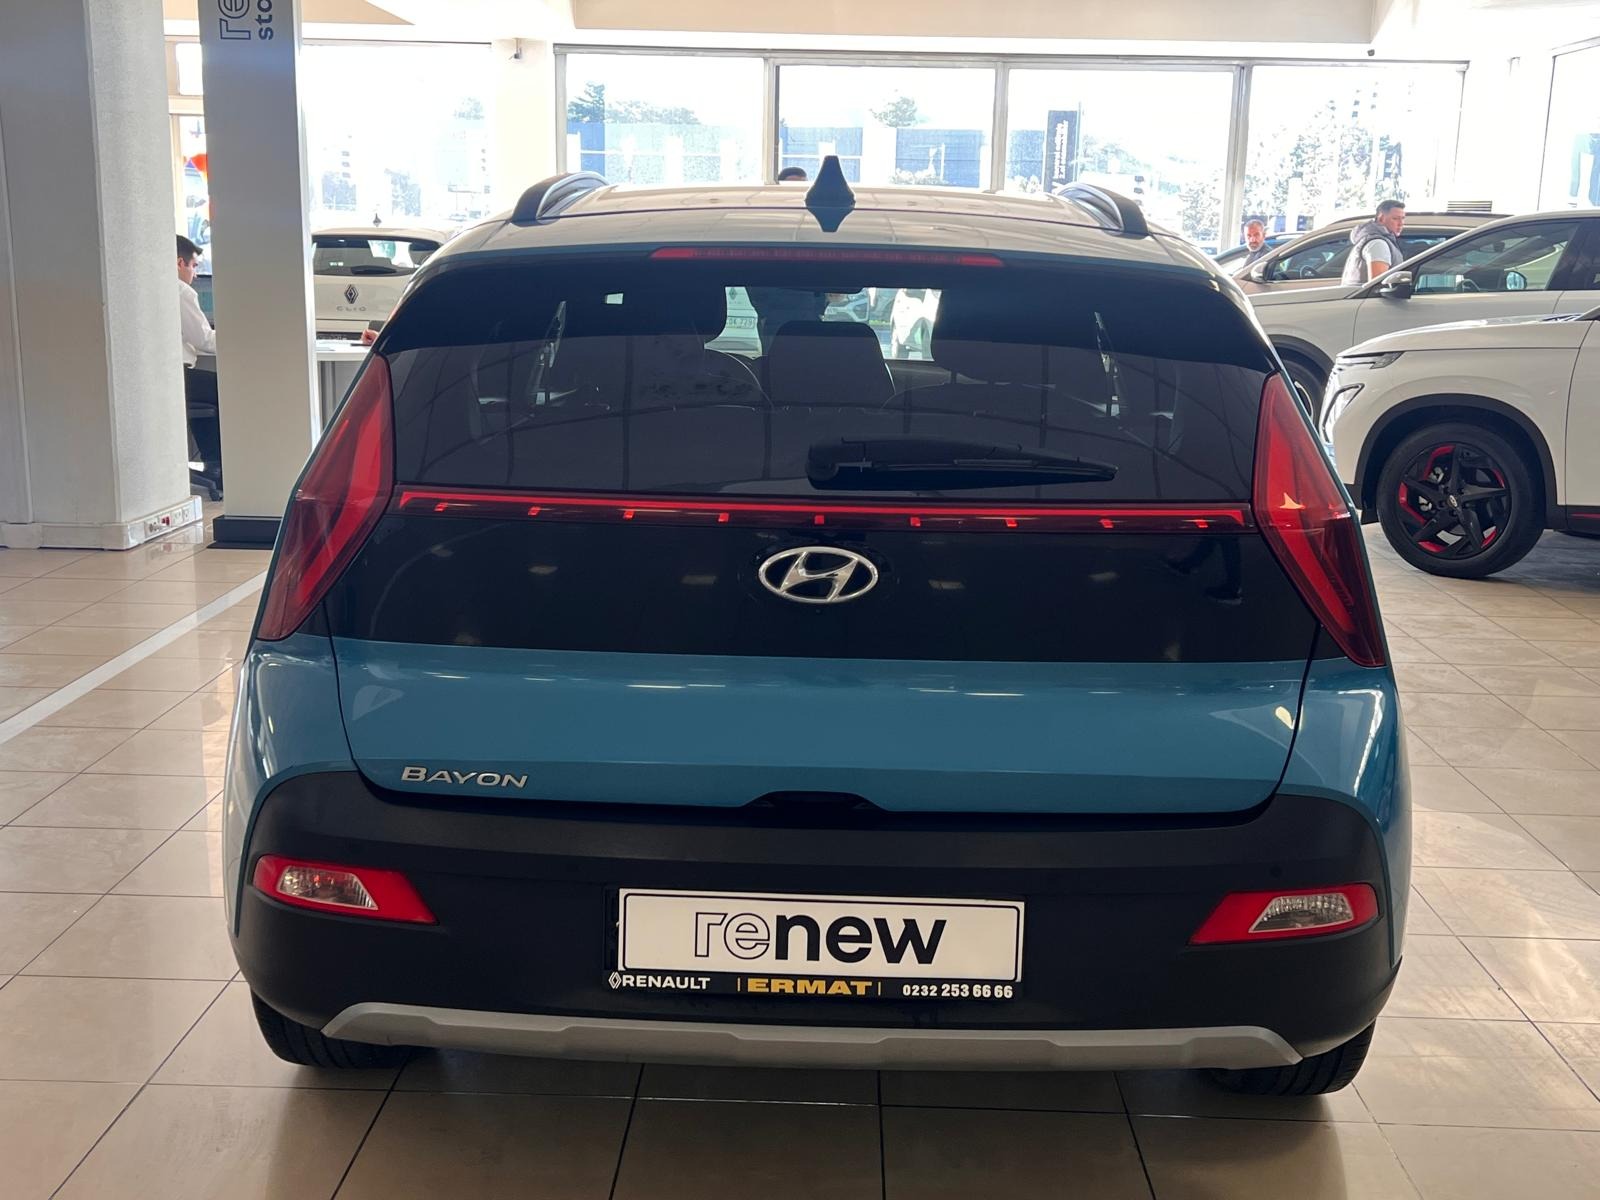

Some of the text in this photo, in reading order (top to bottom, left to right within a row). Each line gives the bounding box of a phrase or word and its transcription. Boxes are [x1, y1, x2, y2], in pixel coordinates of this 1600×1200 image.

[401, 766, 528, 788] BAYON
[694, 911, 948, 965] renew
[622, 975, 711, 991] RENAULT
[747, 978, 873, 996] ERMAT
[902, 984, 938, 996] 0232
[941, 983, 970, 997] 253
